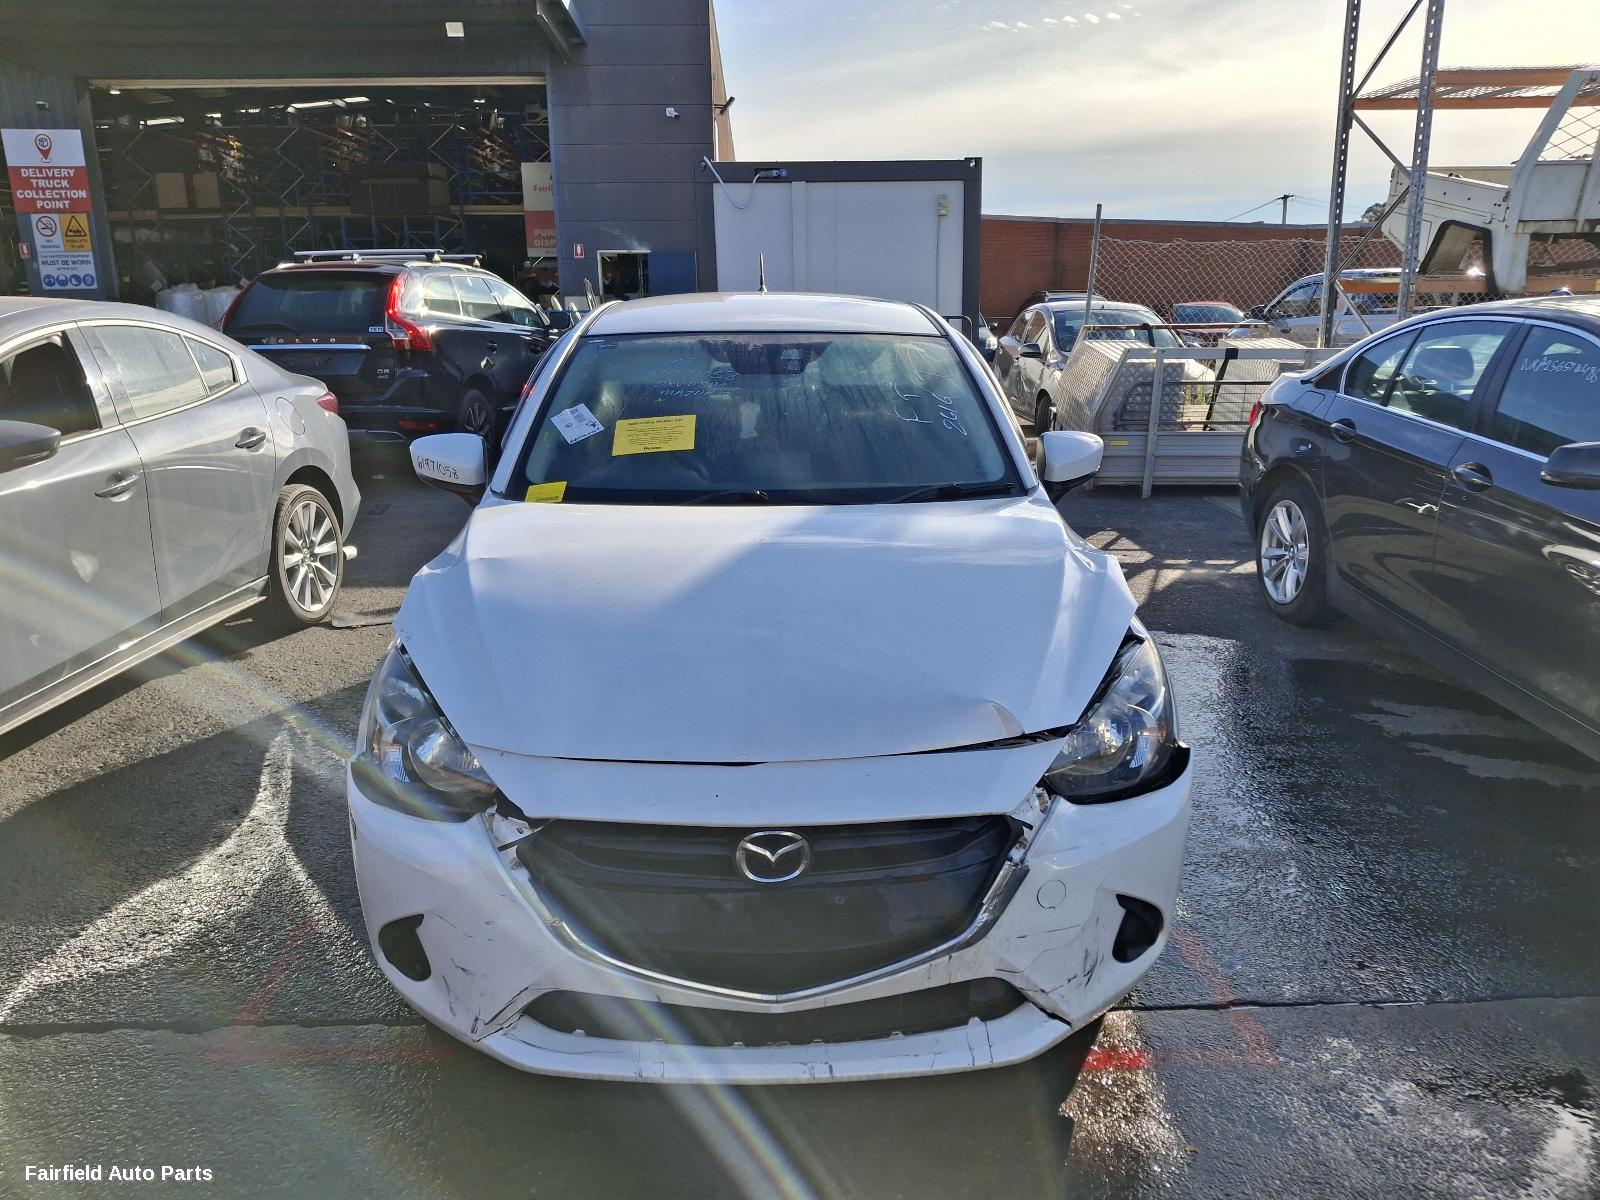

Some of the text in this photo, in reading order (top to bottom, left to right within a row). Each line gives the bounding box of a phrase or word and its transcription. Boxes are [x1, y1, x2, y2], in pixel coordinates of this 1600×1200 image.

[20, 168, 75, 178] DELIVERY
[30, 179, 70, 188] TRUCK
[16, 189, 87, 199] COLLECTION
[36, 200, 70, 209] POINT
